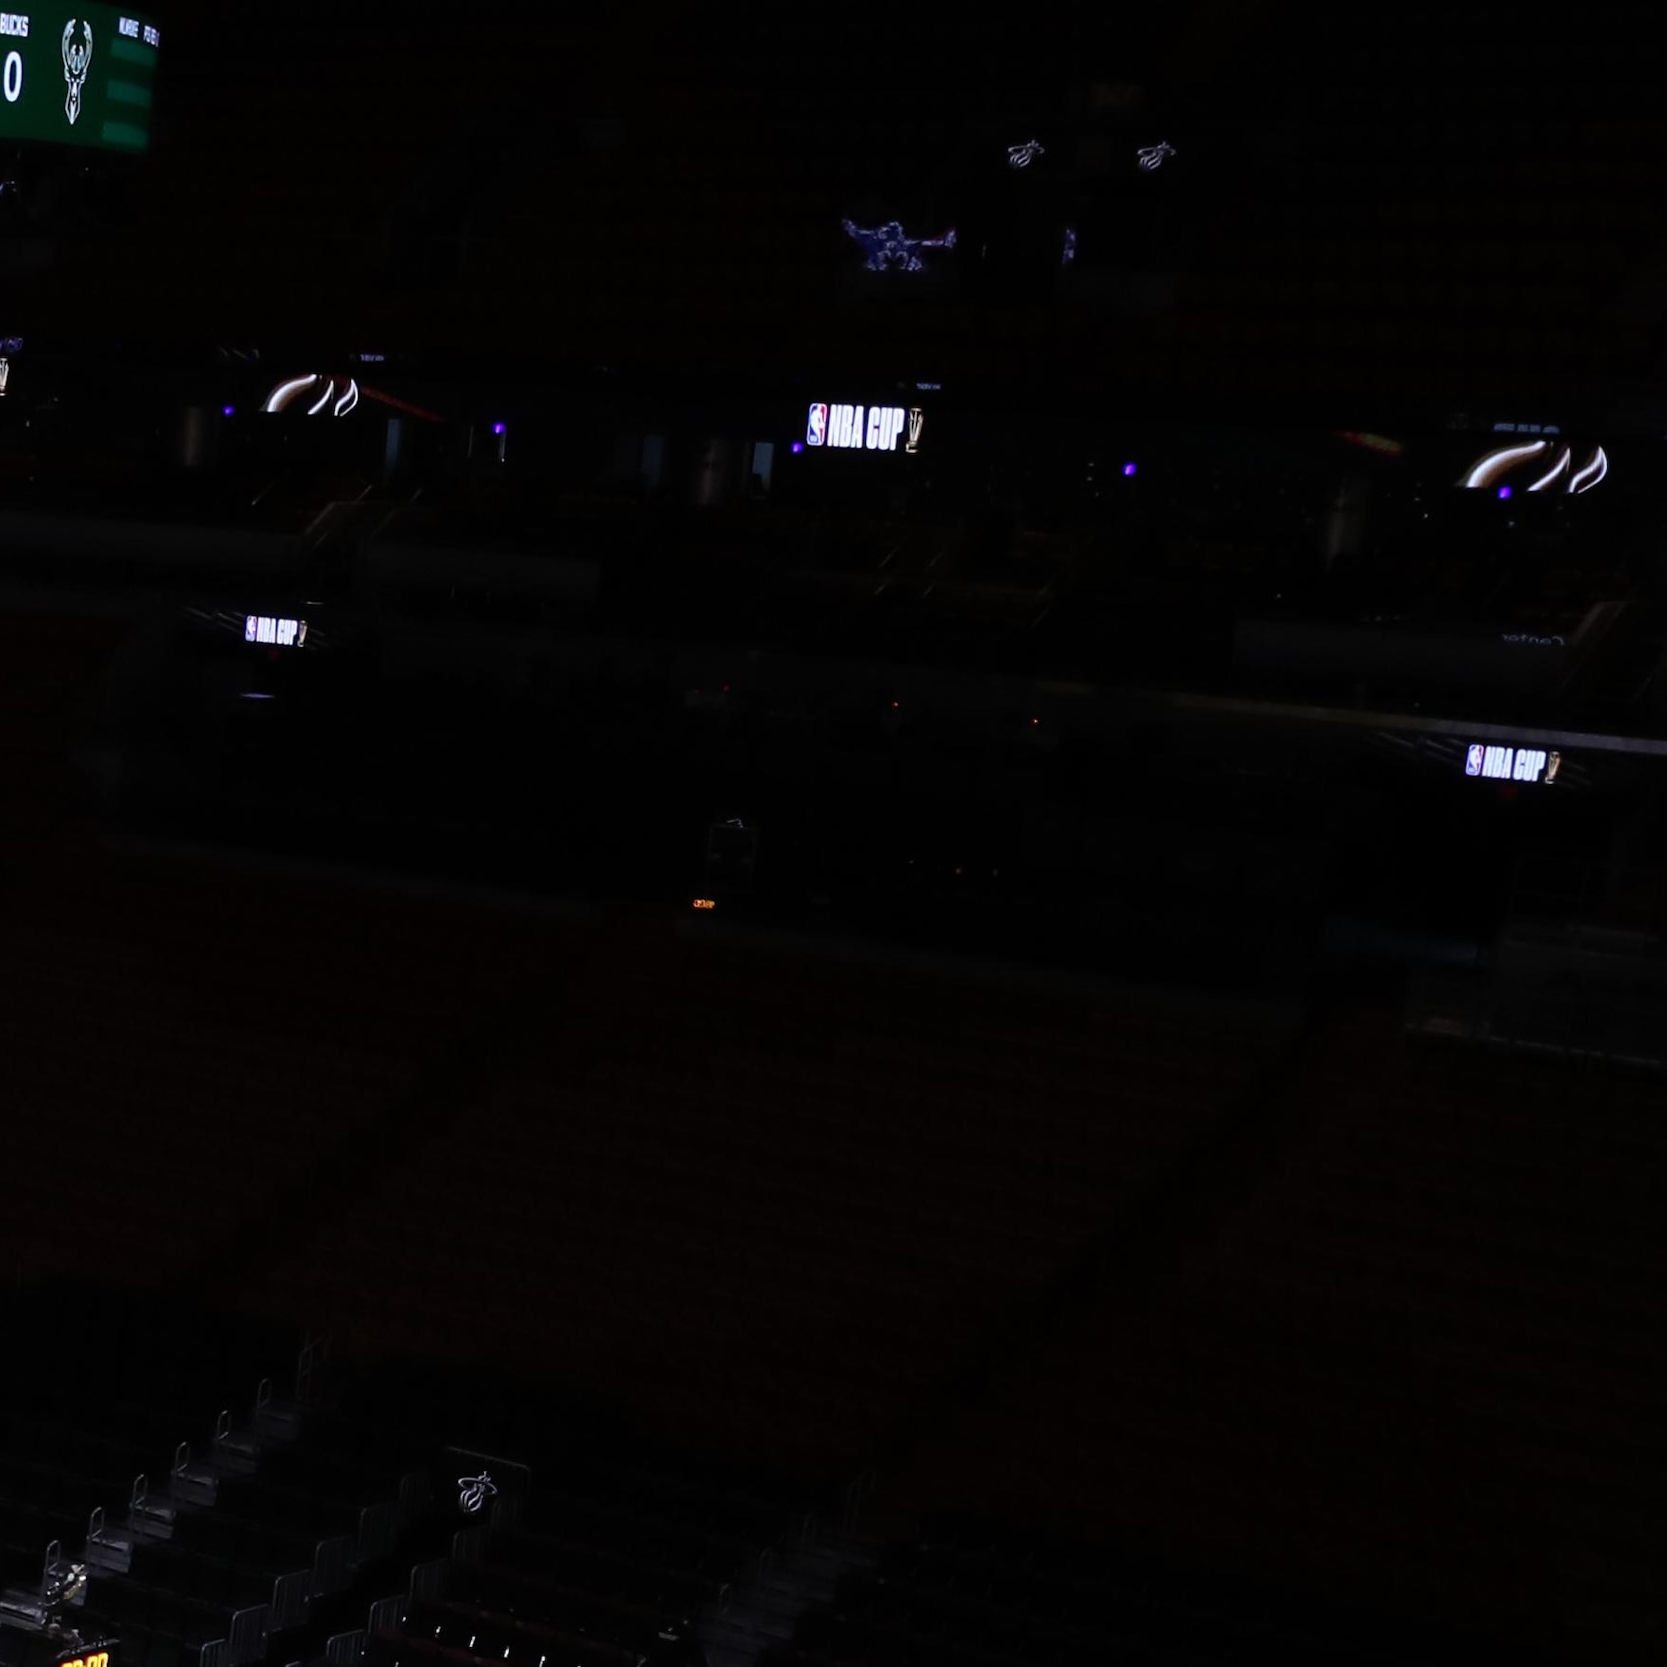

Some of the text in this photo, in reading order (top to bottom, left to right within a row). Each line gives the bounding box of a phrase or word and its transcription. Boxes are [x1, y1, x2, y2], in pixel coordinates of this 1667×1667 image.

[0, 12, 29, 37] BUCKS
[3, 51, 22, 102] 0
[827, 404, 905, 450] NBA CUP
